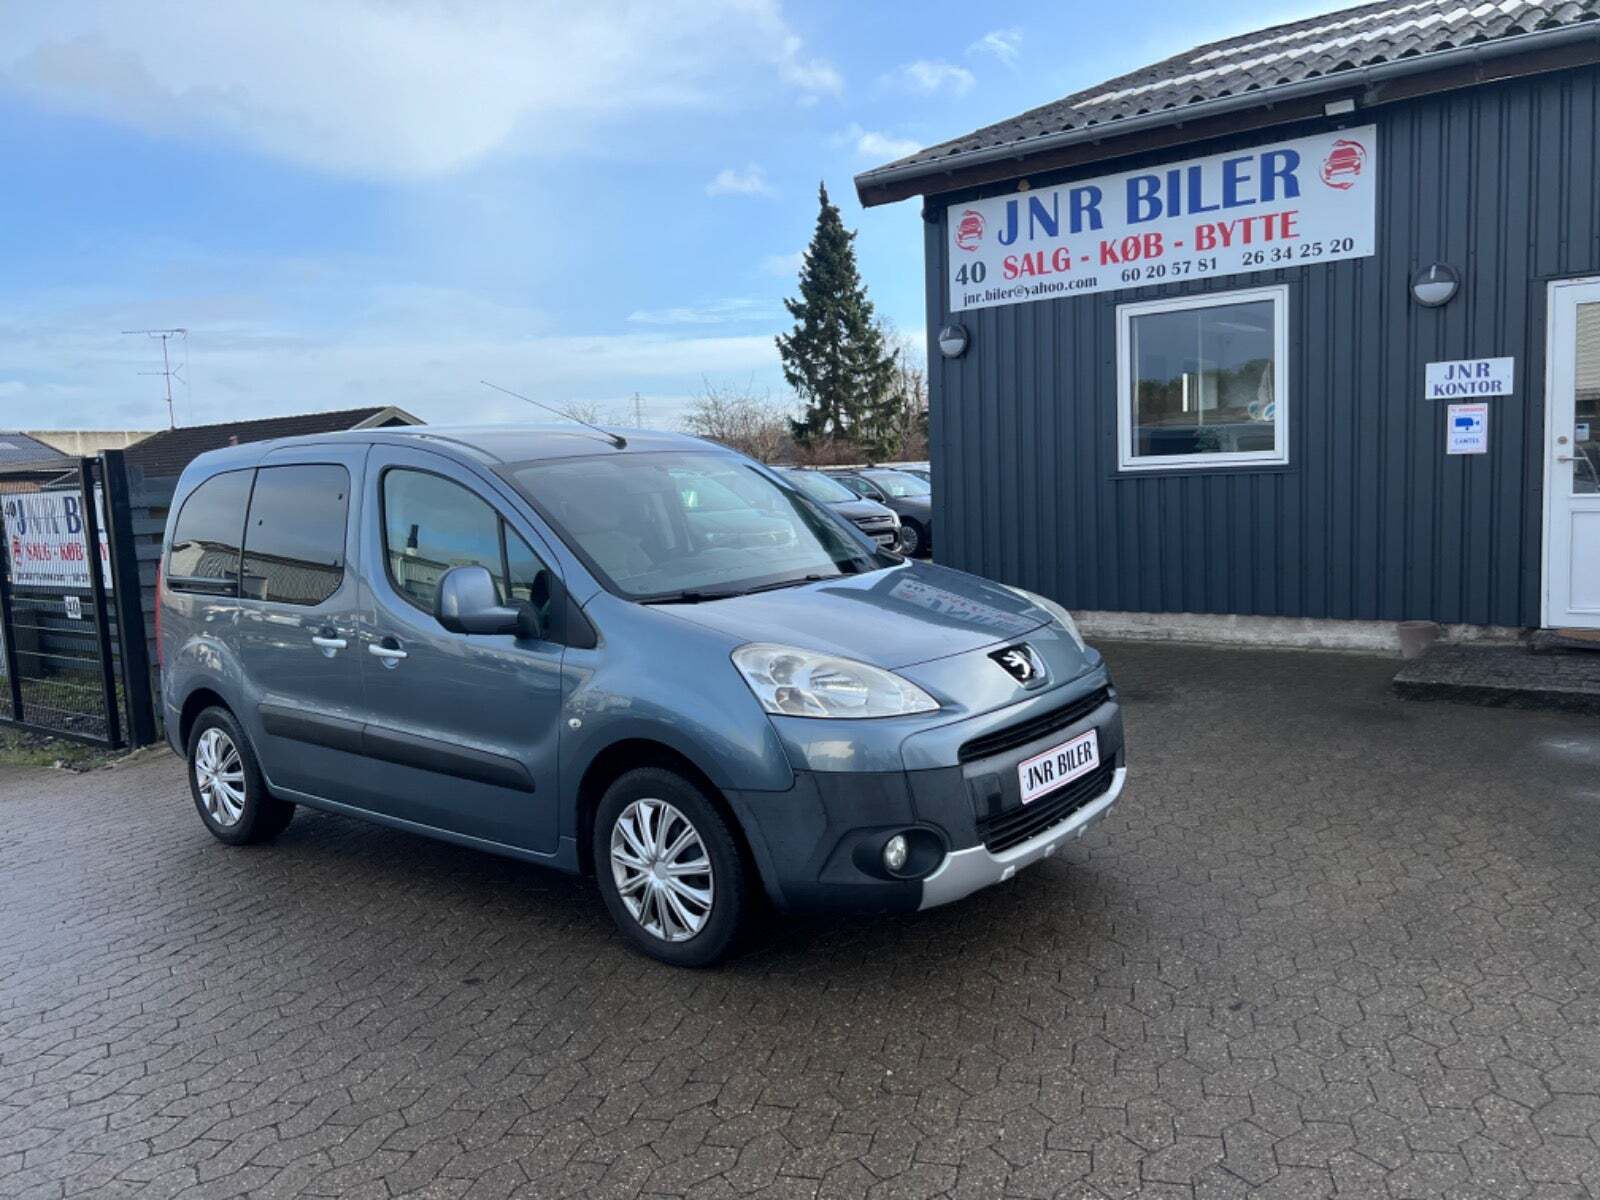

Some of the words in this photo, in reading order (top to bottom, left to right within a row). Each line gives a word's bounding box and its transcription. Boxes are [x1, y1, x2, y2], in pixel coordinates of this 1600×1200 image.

[998, 186, 1103, 246] JNR
[1126, 149, 1300, 225] BILER
[1003, 247, 1071, 280] SALG
[1100, 232, 1164, 265] KØB
[1195, 210, 1300, 251] BYTTE
[1242, 251, 1264, 266] 26
[1270, 246, 1292, 262] 34
[1300, 242, 1323, 258] 25
[1330, 237, 1354, 254] 20
[955, 261, 986, 285] 40
[1121, 266, 1140, 282] 60
[1146, 264, 1166, 278] 20
[1171, 261, 1192, 276] 57
[1198, 257, 1217, 272] 81
[963, 276, 1098, 306] jnr.biler@yahoo.com
[1444, 362, 1490, 380] JNR
[1434, 380, 1503, 396] KONTOR
[1027, 760, 1054, 791] JNR
[1057, 741, 1093, 776] BILER
